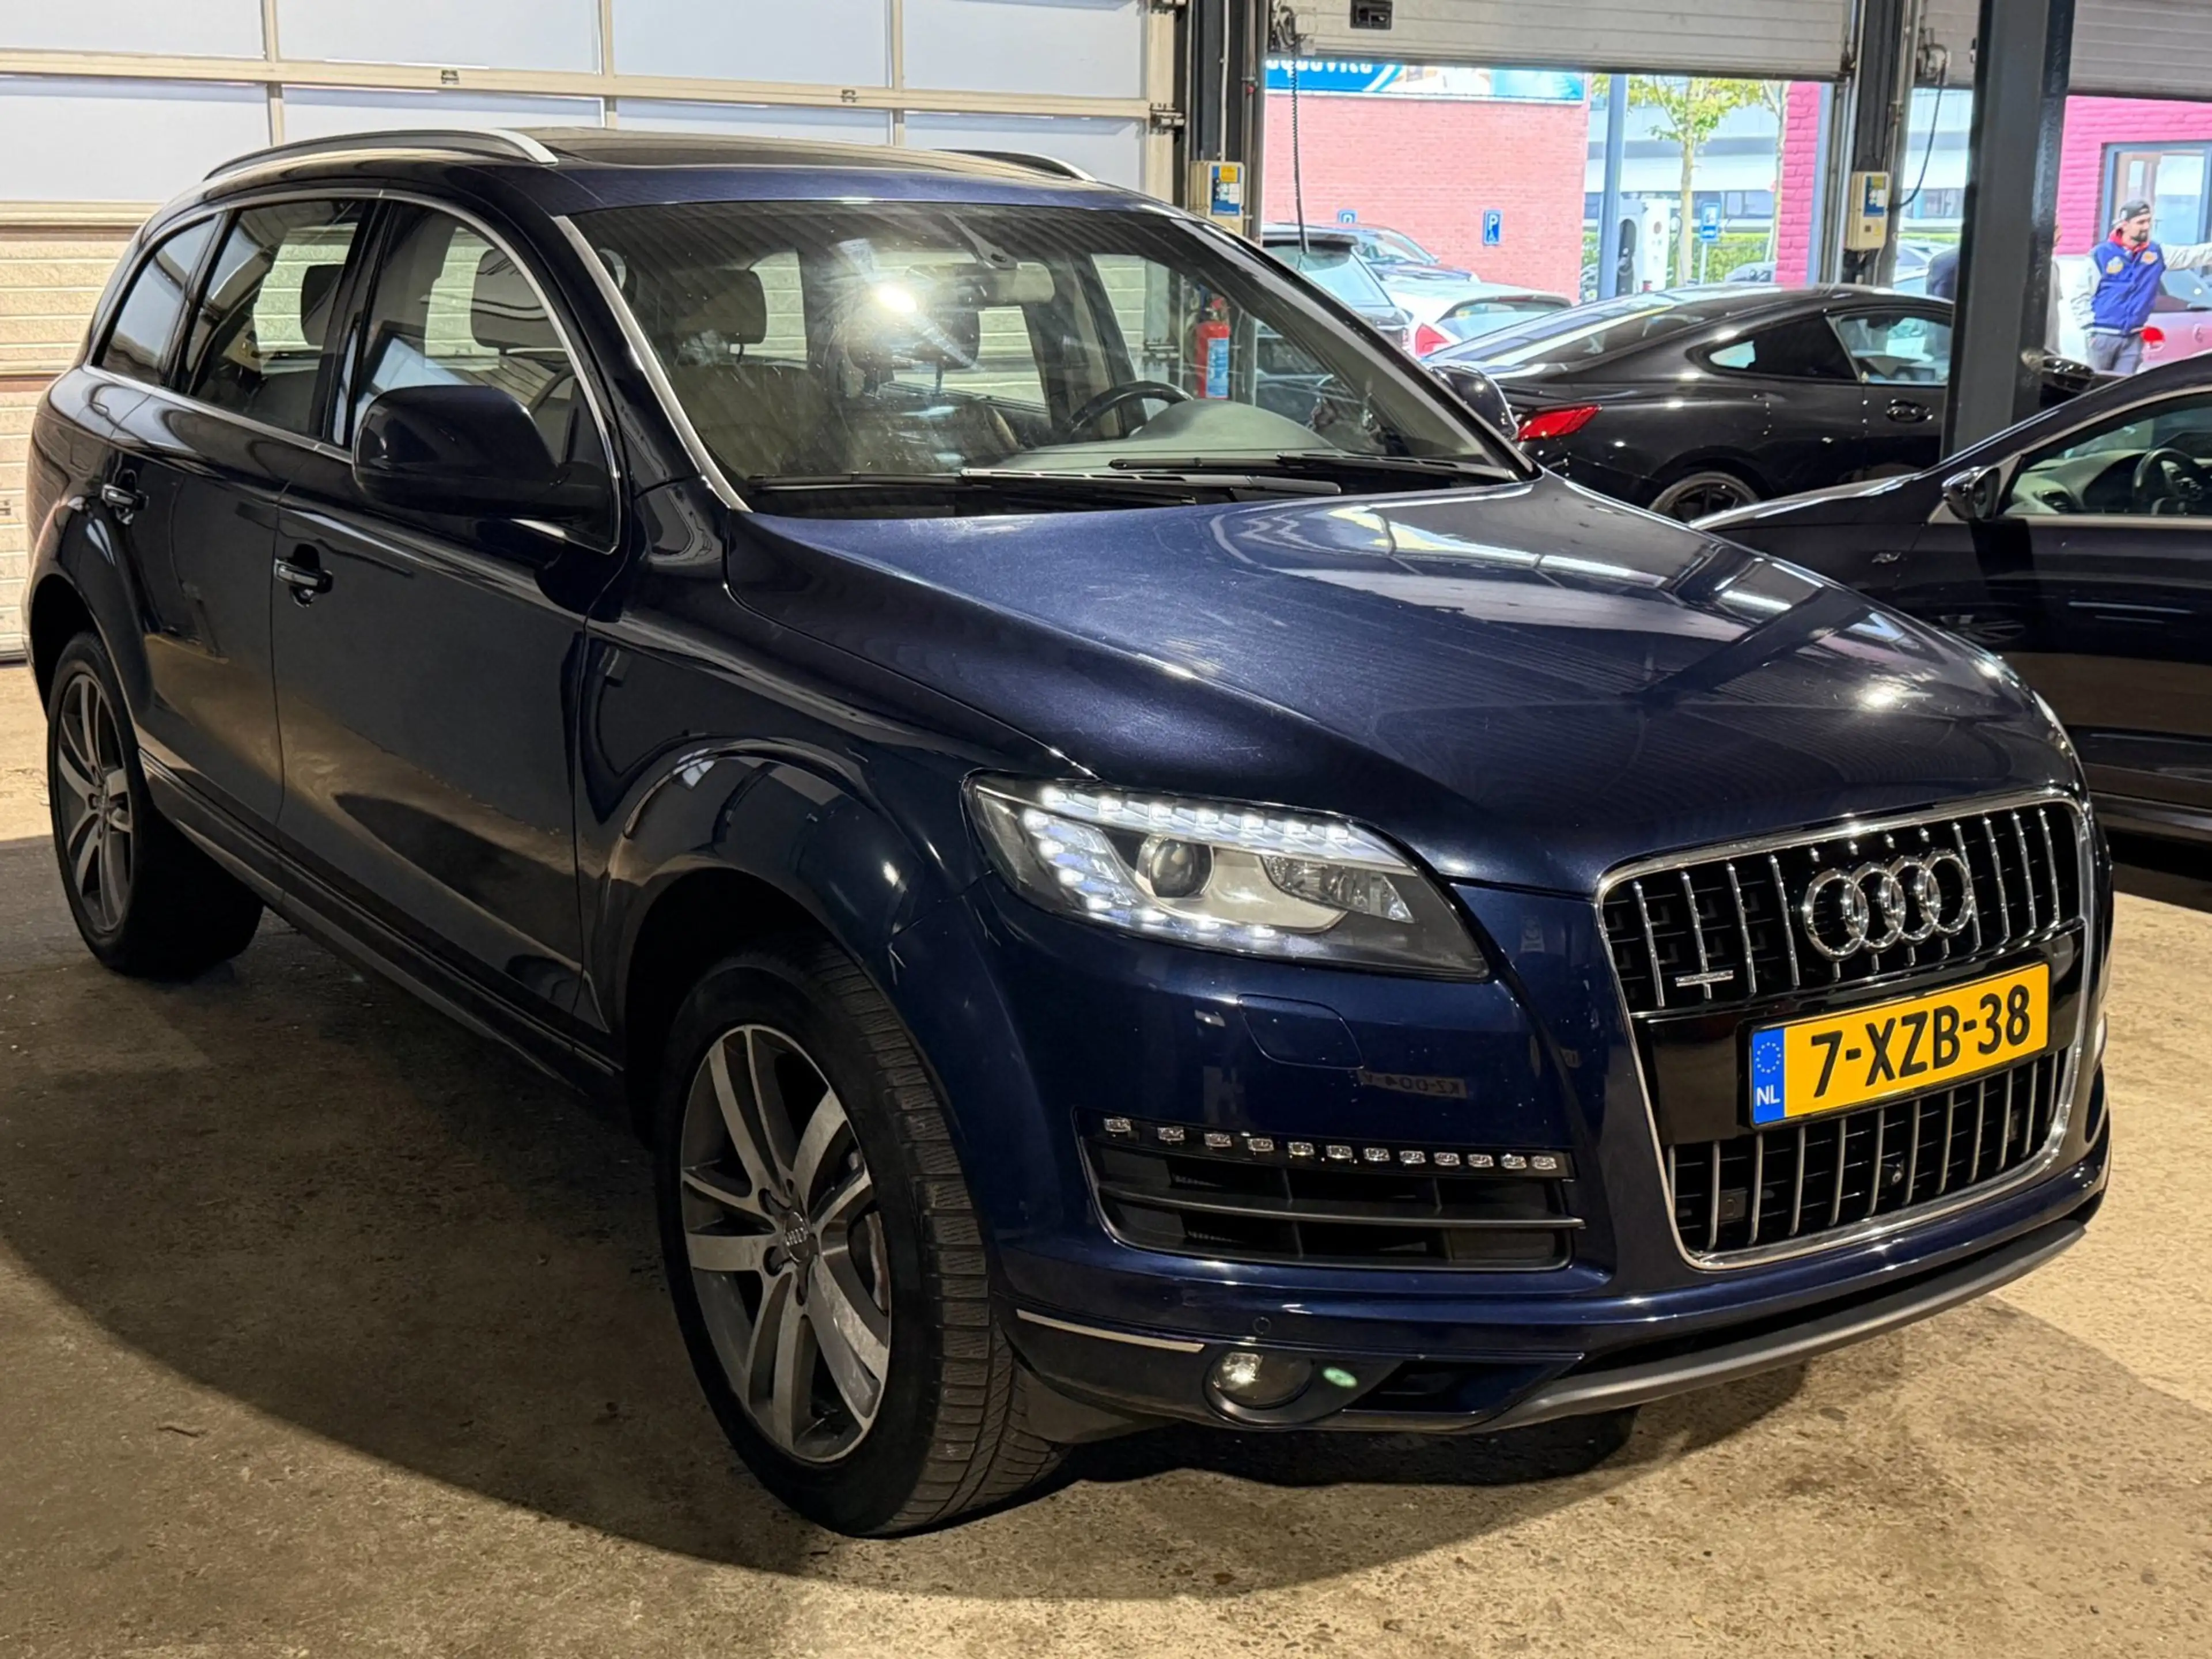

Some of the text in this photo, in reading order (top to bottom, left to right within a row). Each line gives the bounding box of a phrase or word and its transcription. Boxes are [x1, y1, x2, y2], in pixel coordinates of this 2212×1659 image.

[1488, 214, 1498, 230] P
[1810, 984, 2031, 1098] 7-XZB-38
[1756, 1085, 1781, 1106] NL
